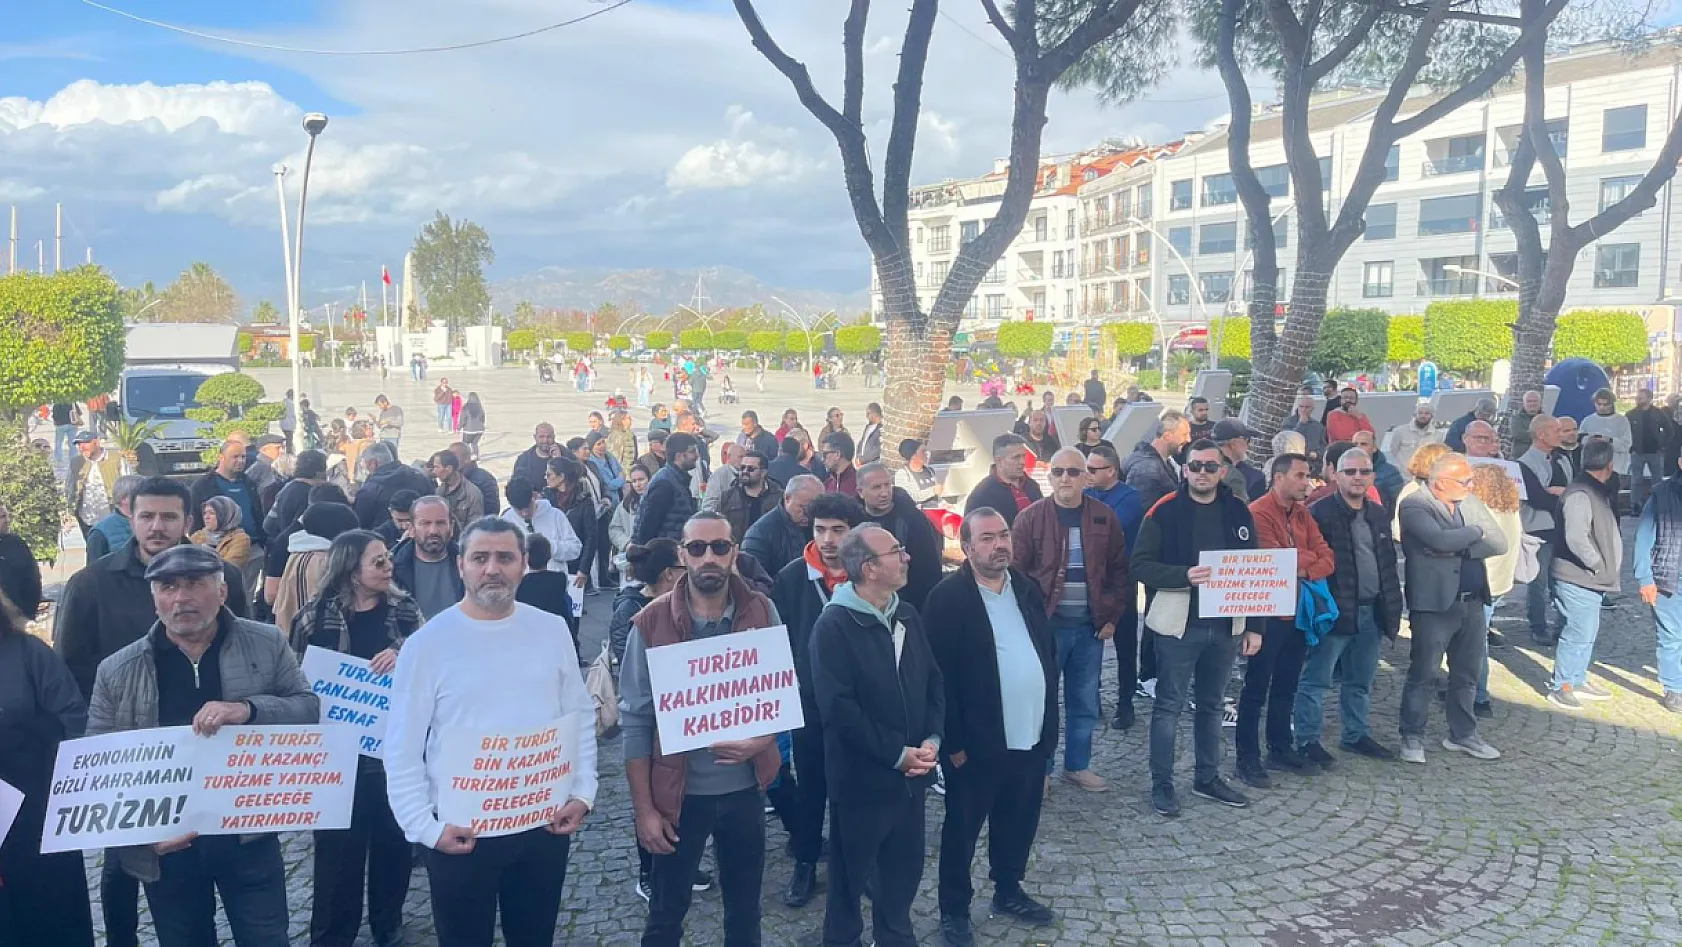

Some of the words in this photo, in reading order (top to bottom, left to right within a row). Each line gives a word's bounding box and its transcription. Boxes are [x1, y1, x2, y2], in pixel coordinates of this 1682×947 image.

[1219, 604, 1276, 614] YATIRIMDIR!
[688, 646, 758, 677] TURİZM
[659, 669, 794, 712] KALKINMANIN
[327, 705, 378, 727] ESNAF
[684, 698, 780, 736] KALBİDİR!
[235, 730, 264, 748] BİR
[269, 729, 323, 748] TURİST,
[482, 734, 508, 751] BİR
[515, 727, 558, 750] TURİST,
[73, 740, 176, 770] EKONOMİNİN
[227, 750, 256, 768] BİN
[260, 752, 328, 768] KAZANÇ!
[474, 754, 503, 770] BİN
[507, 744, 562, 770] KAZANÇ!
[52, 773, 88, 796] GİZLİ
[90, 766, 193, 791] KAHRAMANI
[203, 772, 274, 790] TURİZME
[278, 772, 344, 786] YATIRIM,
[452, 774, 519, 792] TURİZME
[234, 788, 313, 808] GELECEĞE
[55, 792, 188, 836] TURİZM!
[220, 812, 321, 829] YATIRIMDIR!
